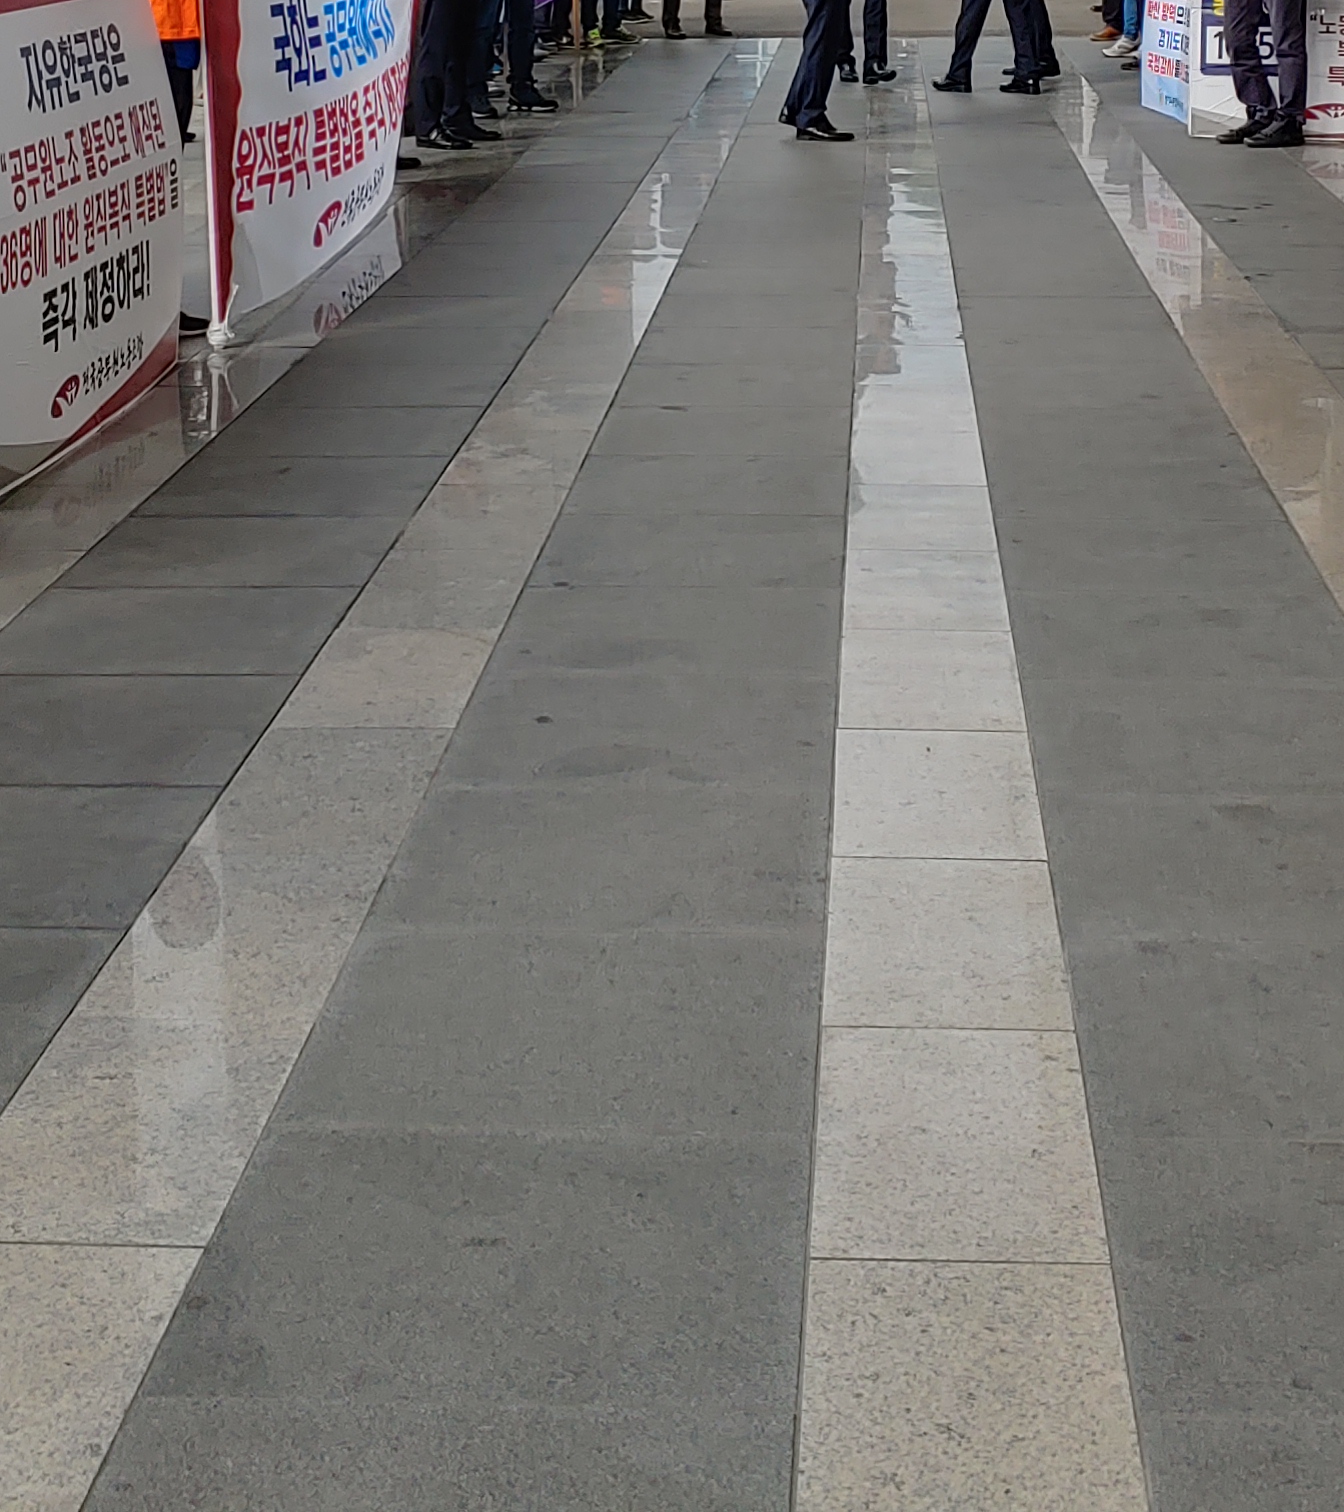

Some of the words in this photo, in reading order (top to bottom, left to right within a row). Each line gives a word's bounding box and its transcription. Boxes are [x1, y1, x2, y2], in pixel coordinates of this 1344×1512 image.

[19, 23, 129, 114] 자유한국당은
[79, 111, 132, 180] 활동으로
[128, 97, 166, 159] 해직된
[235, 111, 312, 215] 원직복직
[311, 90, 366, 183] 특별법을
[362, 75, 387, 152] 즉각
[53, 202, 79, 270] 대한
[83, 179, 132, 254] 원직복직
[42, 277, 78, 353] 즉각
[83, 239, 151, 331] 제정하라!
